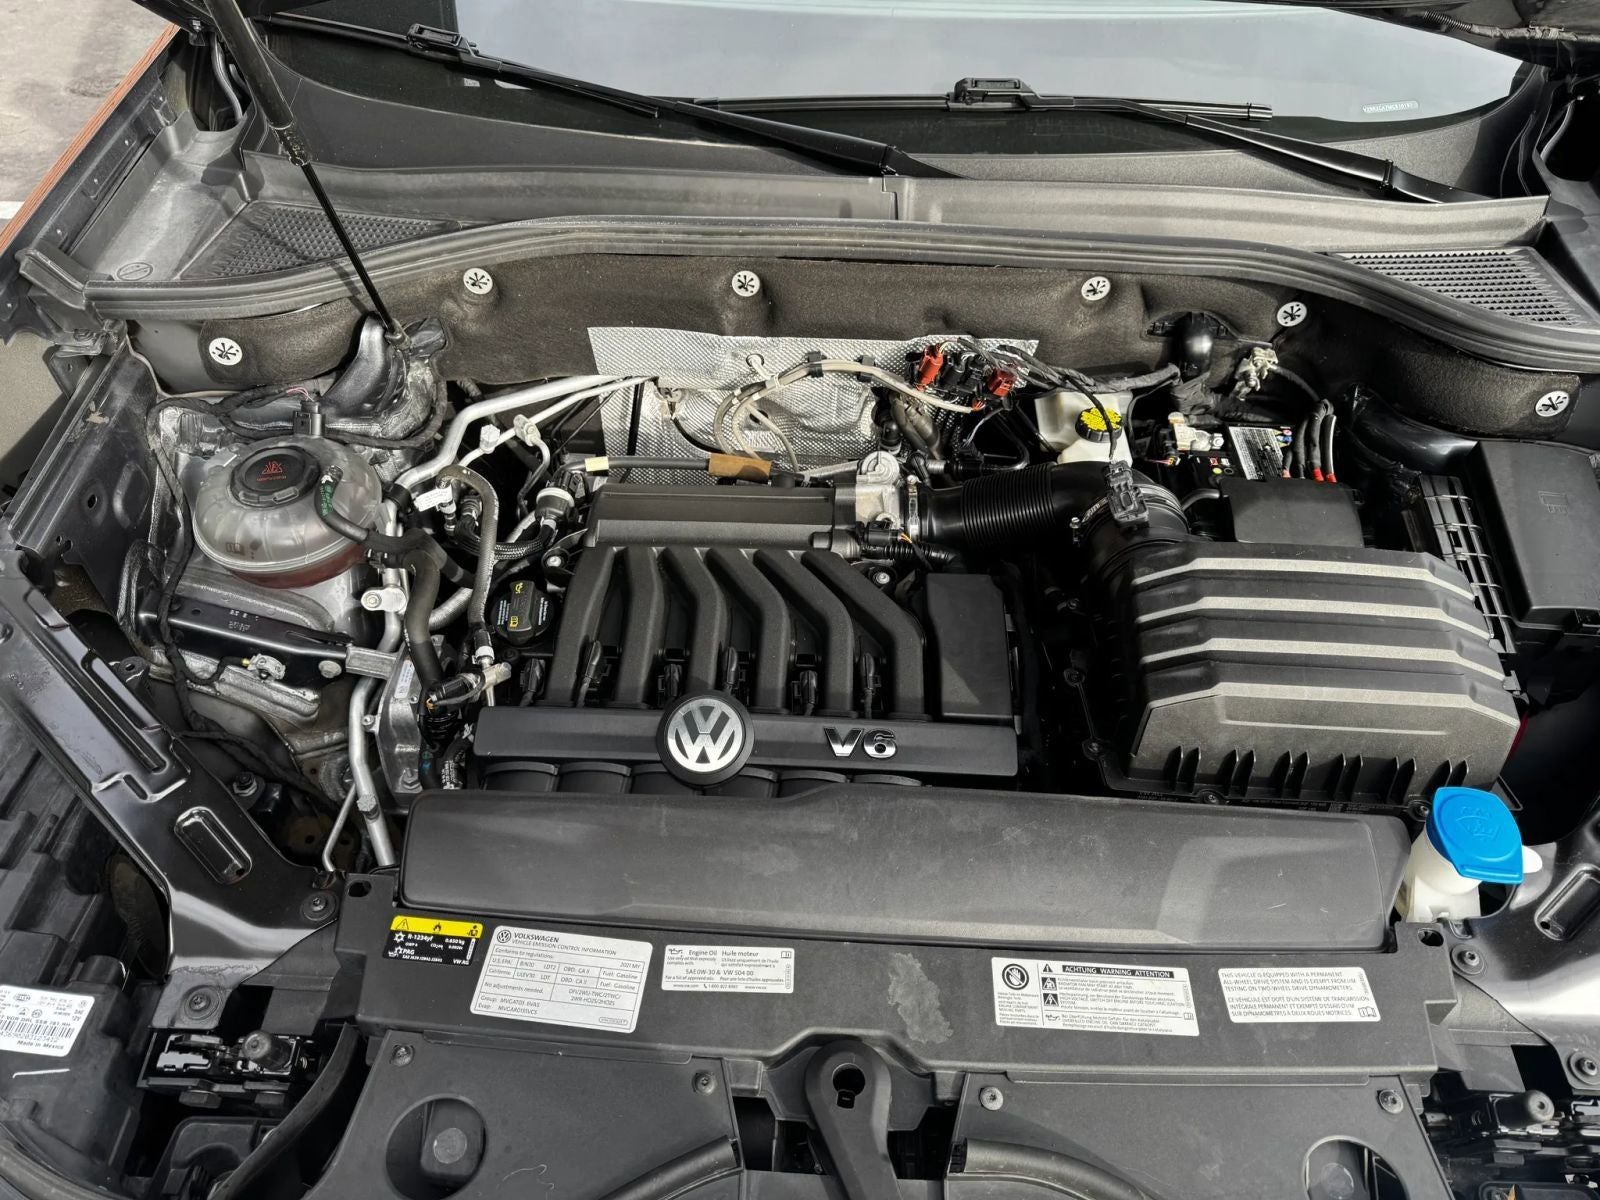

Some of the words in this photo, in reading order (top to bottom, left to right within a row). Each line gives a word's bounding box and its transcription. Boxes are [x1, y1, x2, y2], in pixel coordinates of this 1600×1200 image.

[823, 726, 898, 759] V6
[407, 933, 434, 942] R-1234yf
[514, 932, 560, 943] VOLKSWAGEN
[533, 941, 556, 949] EMISSION
[558, 944, 580, 952] CONTROL
[582, 948, 616, 956] INFORMATION
[1065, 966, 1097, 974] ACHTUNG
[1100, 968, 1132, 976] WARNING
[1135, 970, 1170, 978] ATTENTION
[493, 983, 524, 992] adjustments
